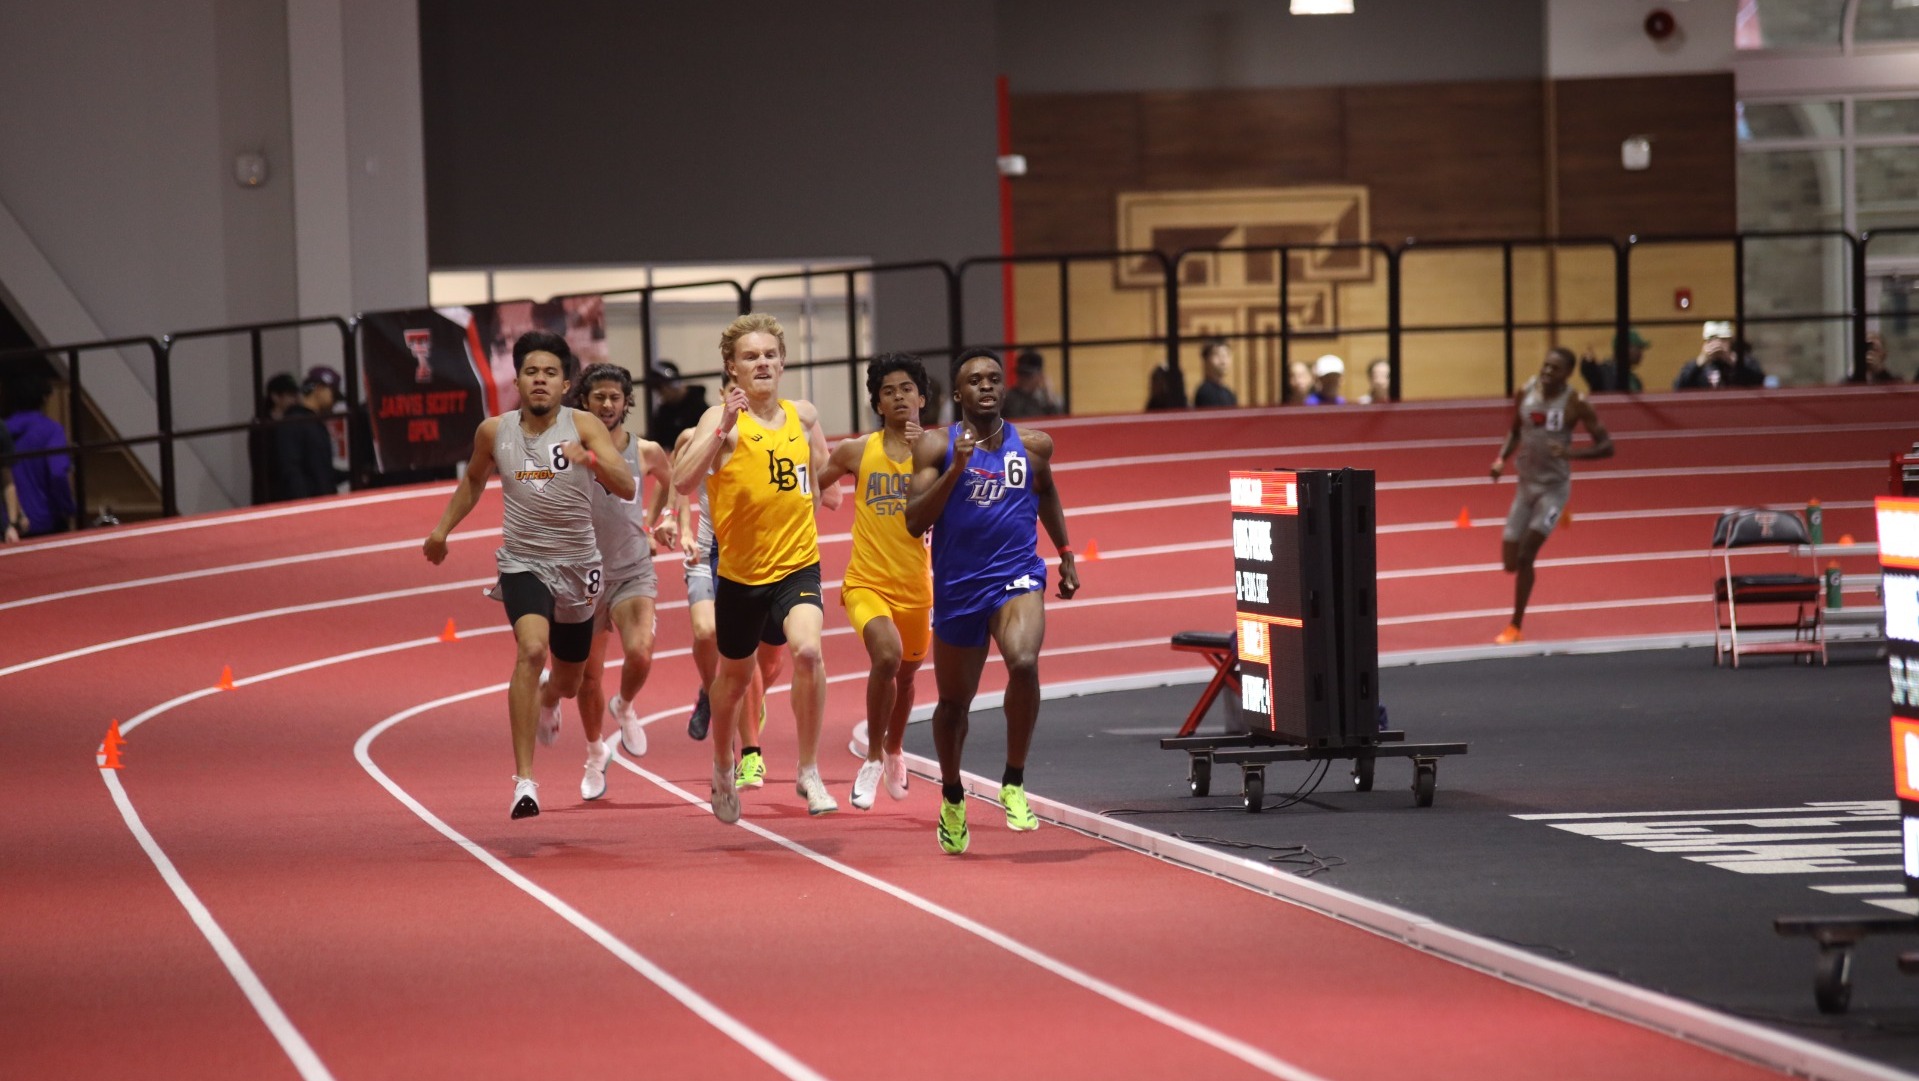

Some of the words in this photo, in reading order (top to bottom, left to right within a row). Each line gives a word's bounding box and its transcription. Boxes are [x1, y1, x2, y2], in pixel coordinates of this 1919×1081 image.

[379, 393, 423, 418] JARVIS
[427, 390, 468, 415] SCOTT
[407, 419, 440, 442] OPEN
[552, 444, 570, 471] 8
[798, 466, 809, 493] 7
[1007, 459, 1024, 487] 6
[876, 501, 906, 516] STA
[587, 569, 601, 595] 8
